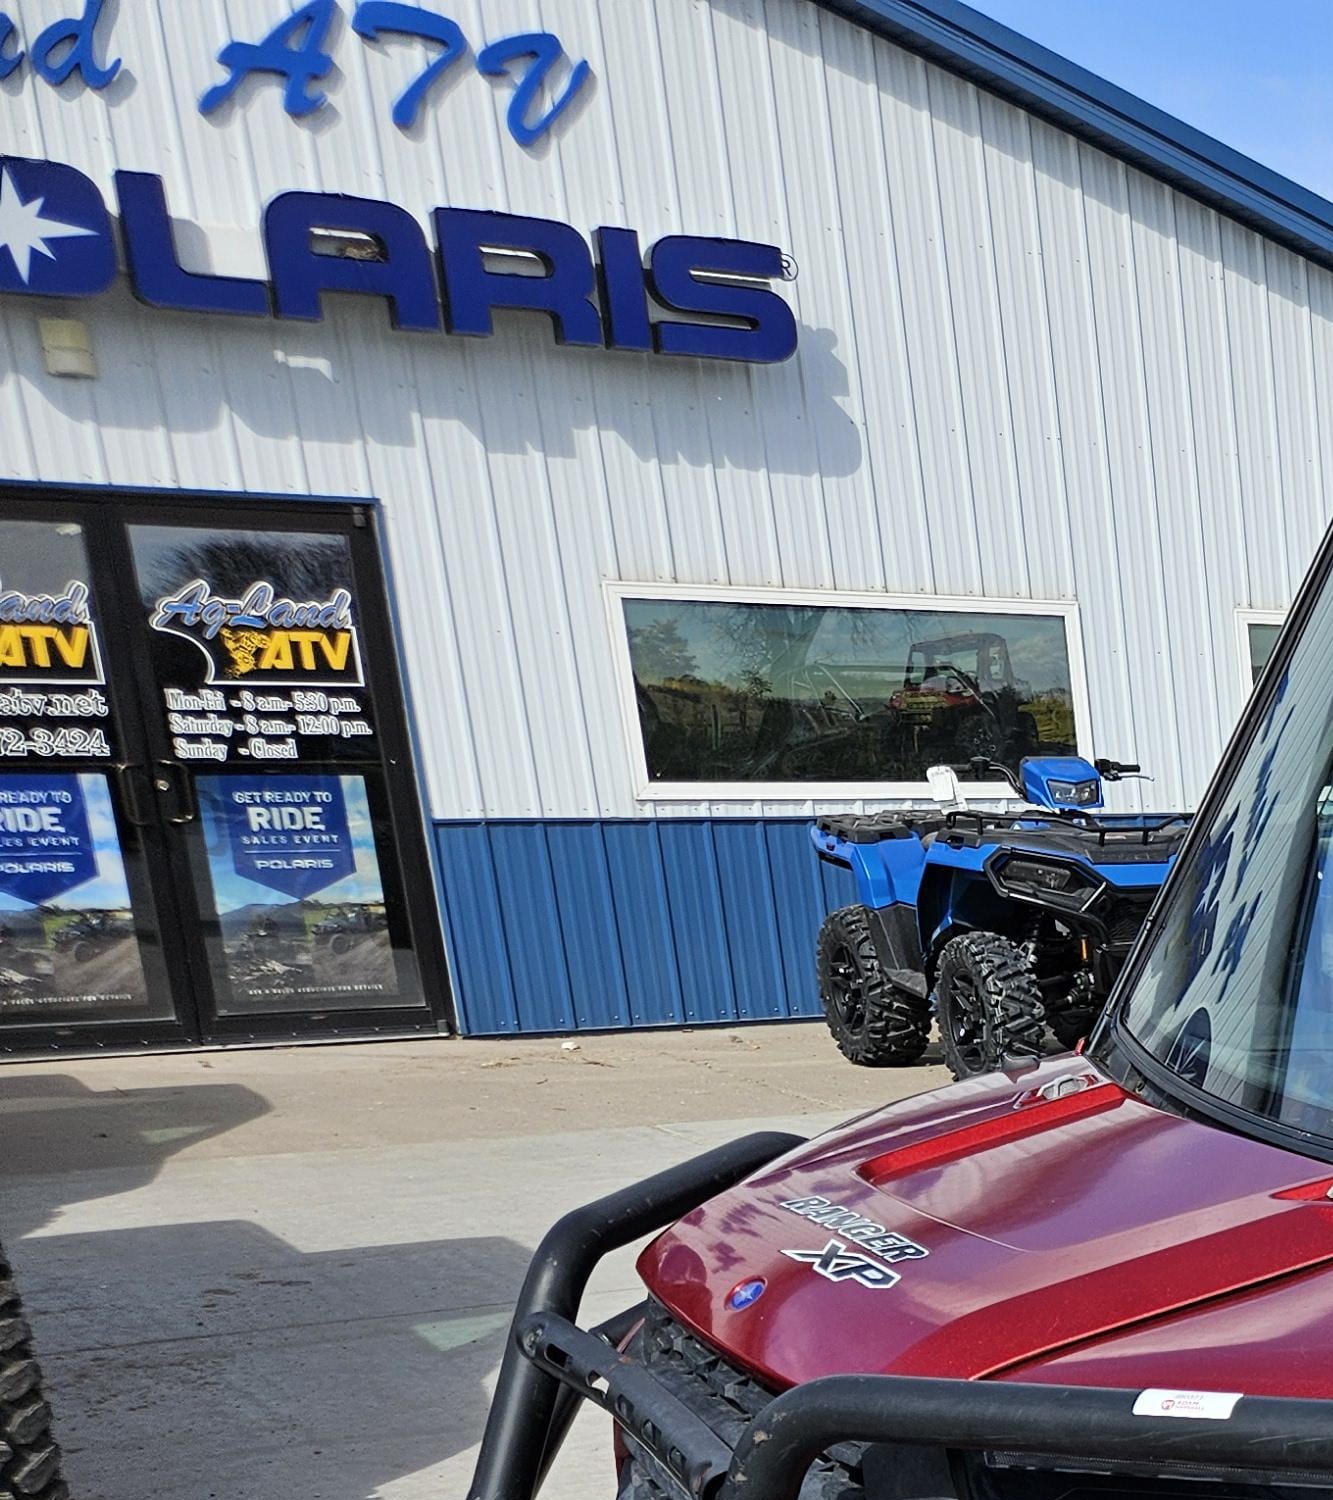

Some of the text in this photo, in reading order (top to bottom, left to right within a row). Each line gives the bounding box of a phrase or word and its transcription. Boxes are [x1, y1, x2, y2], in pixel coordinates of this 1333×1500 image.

[198, 0, 590, 147] ATV
[152, 579, 352, 640] Ag-Land
[259, 630, 351, 671] ATV
[164, 688, 226, 711] Mon-Fri
[292, 691, 328, 712] 5:30
[168, 713, 233, 737] Saturday
[296, 715, 340, 735] 12:00
[173, 737, 228, 762] Sunday
[250, 738, 298, 759] Closed
[49, 790, 72, 804] TO
[232, 791, 332, 804] GET READY TO
[246, 806, 326, 832] RIDE
[241, 834, 339, 845] SALES EVENT
[254, 859, 334, 870] POLARIS
[779, 1195, 930, 1264] RANGER
[780, 1238, 902, 1289] XP
